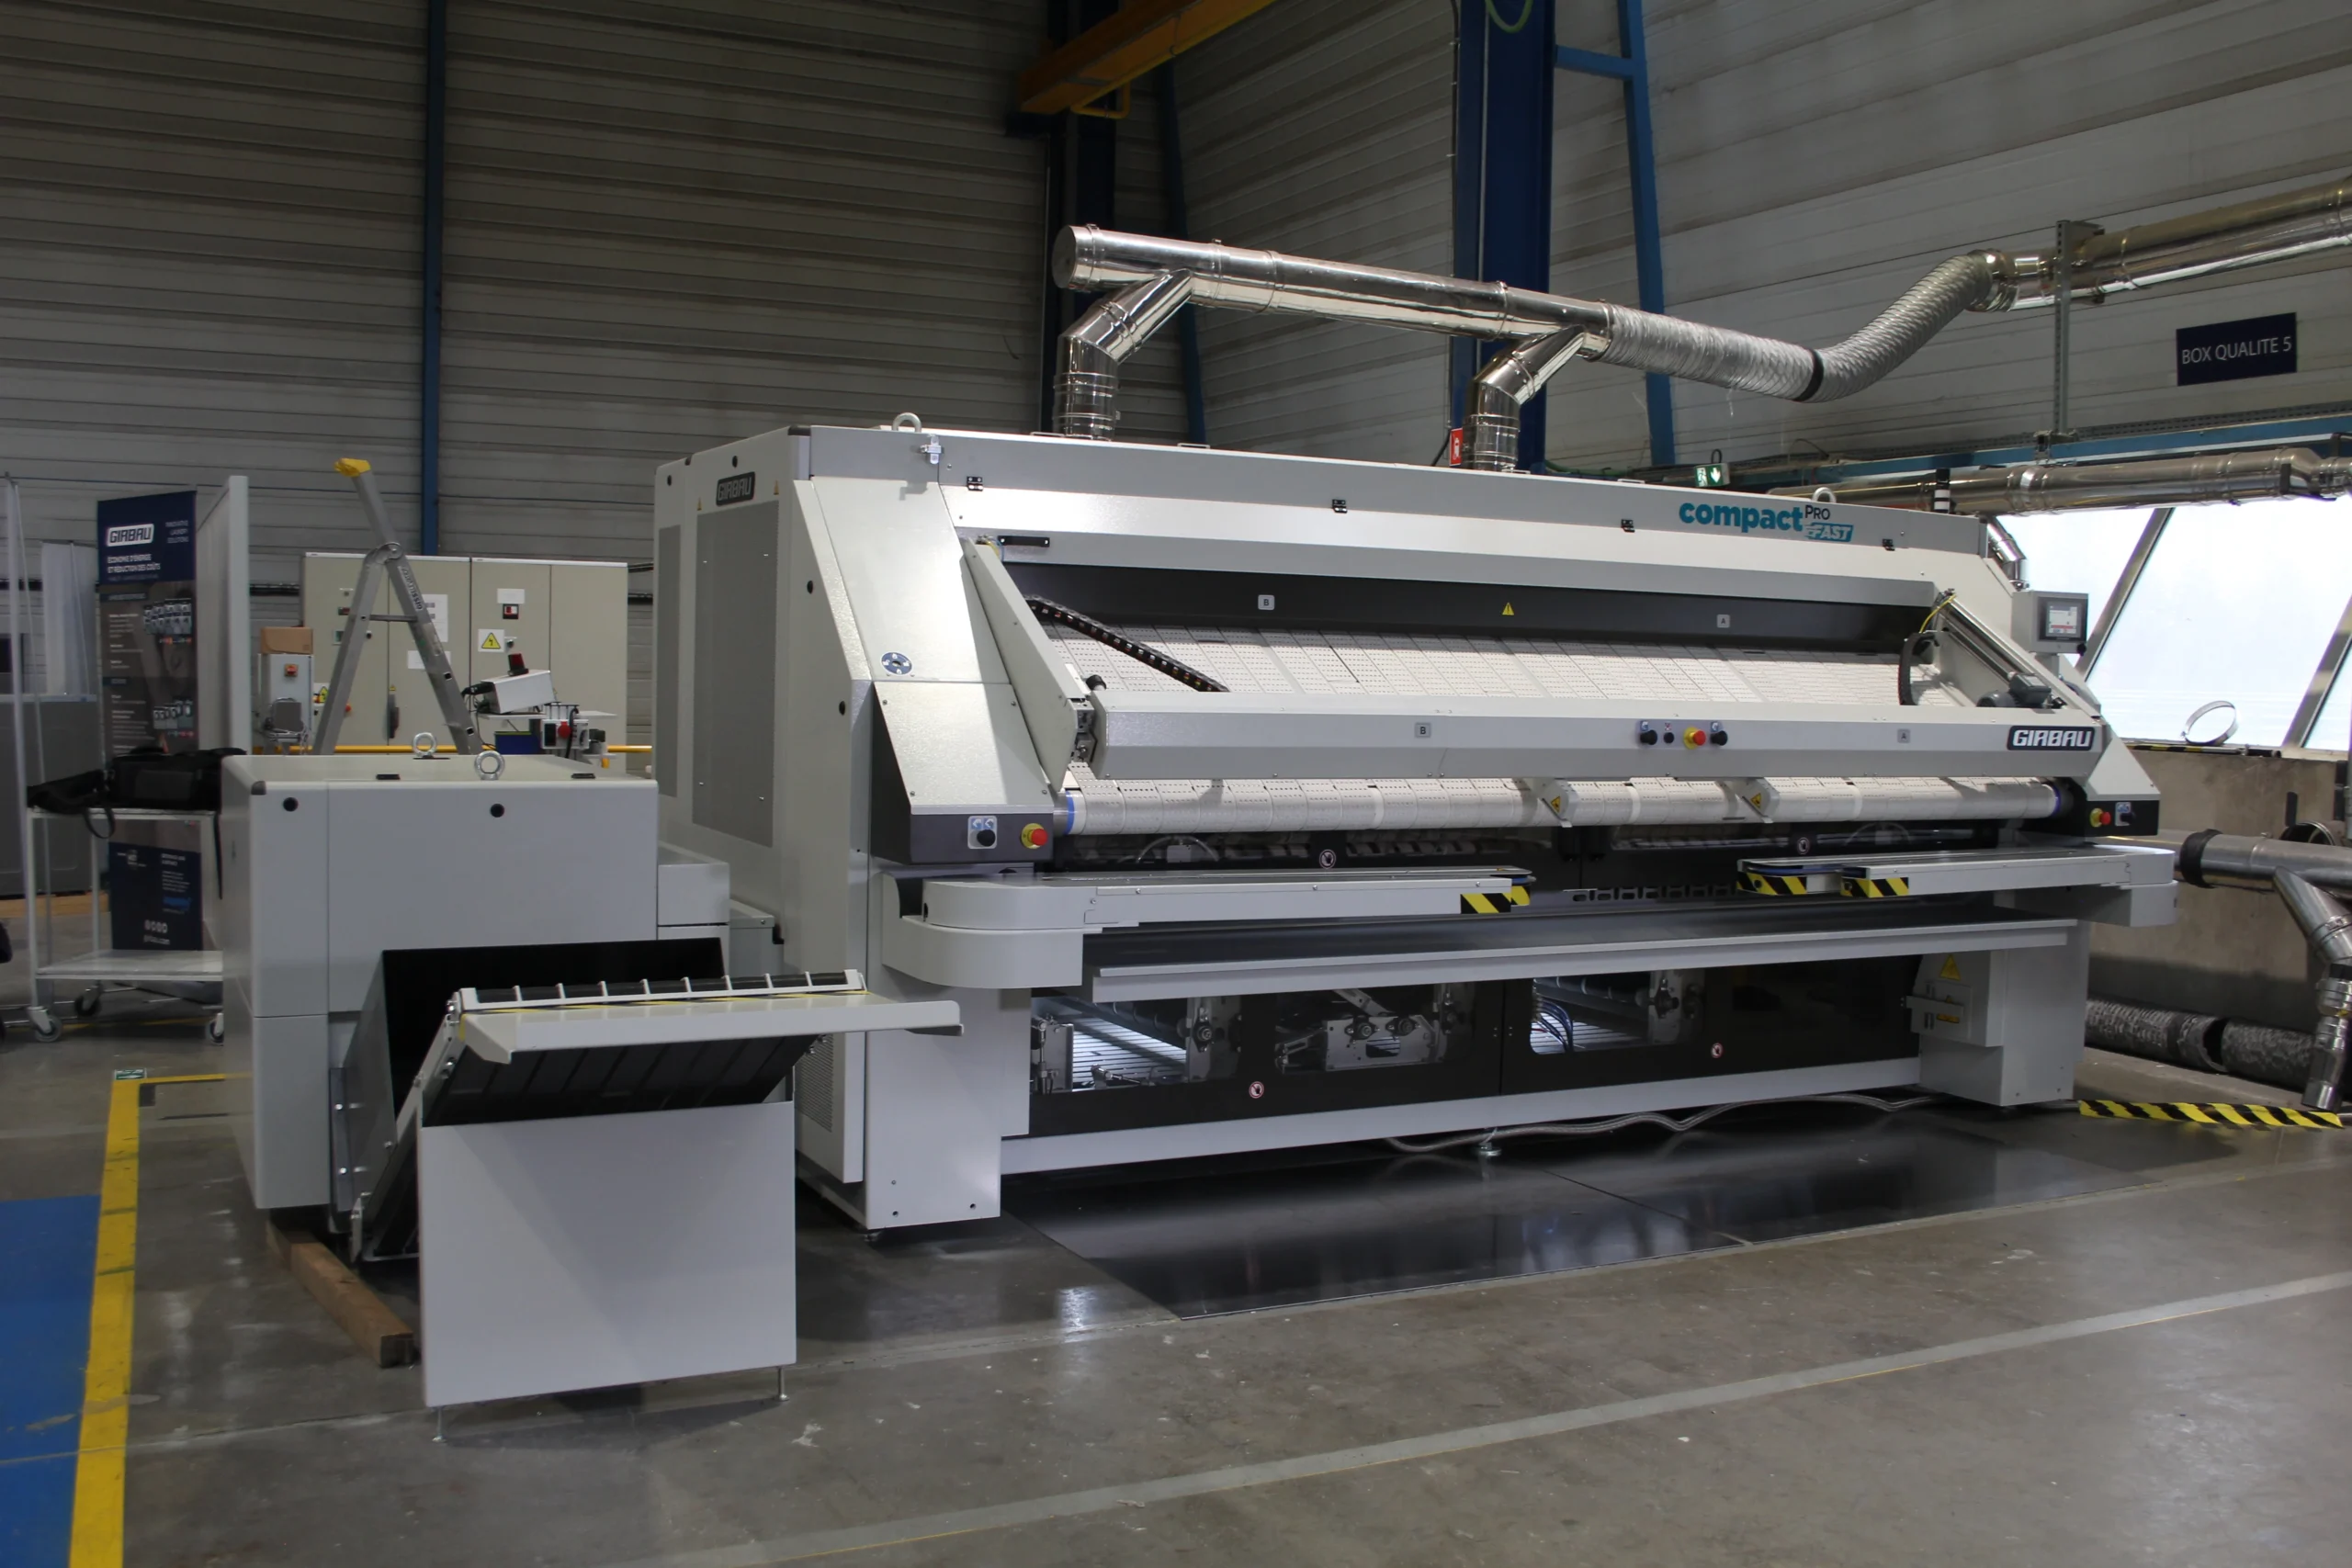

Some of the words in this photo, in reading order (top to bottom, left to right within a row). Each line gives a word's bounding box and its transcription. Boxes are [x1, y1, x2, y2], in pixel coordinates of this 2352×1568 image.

[2181, 346, 2212, 365] BOX
[2214, 337, 2278, 361] QUALITE
[2282, 336, 2292, 352] 5
[718, 476, 752, 502] GIRBAU
[1679, 502, 1804, 533] compact
[1804, 504, 1831, 520] PRO
[109, 527, 153, 544] GIRBAU
[2012, 729, 2093, 747] GIRBAU
